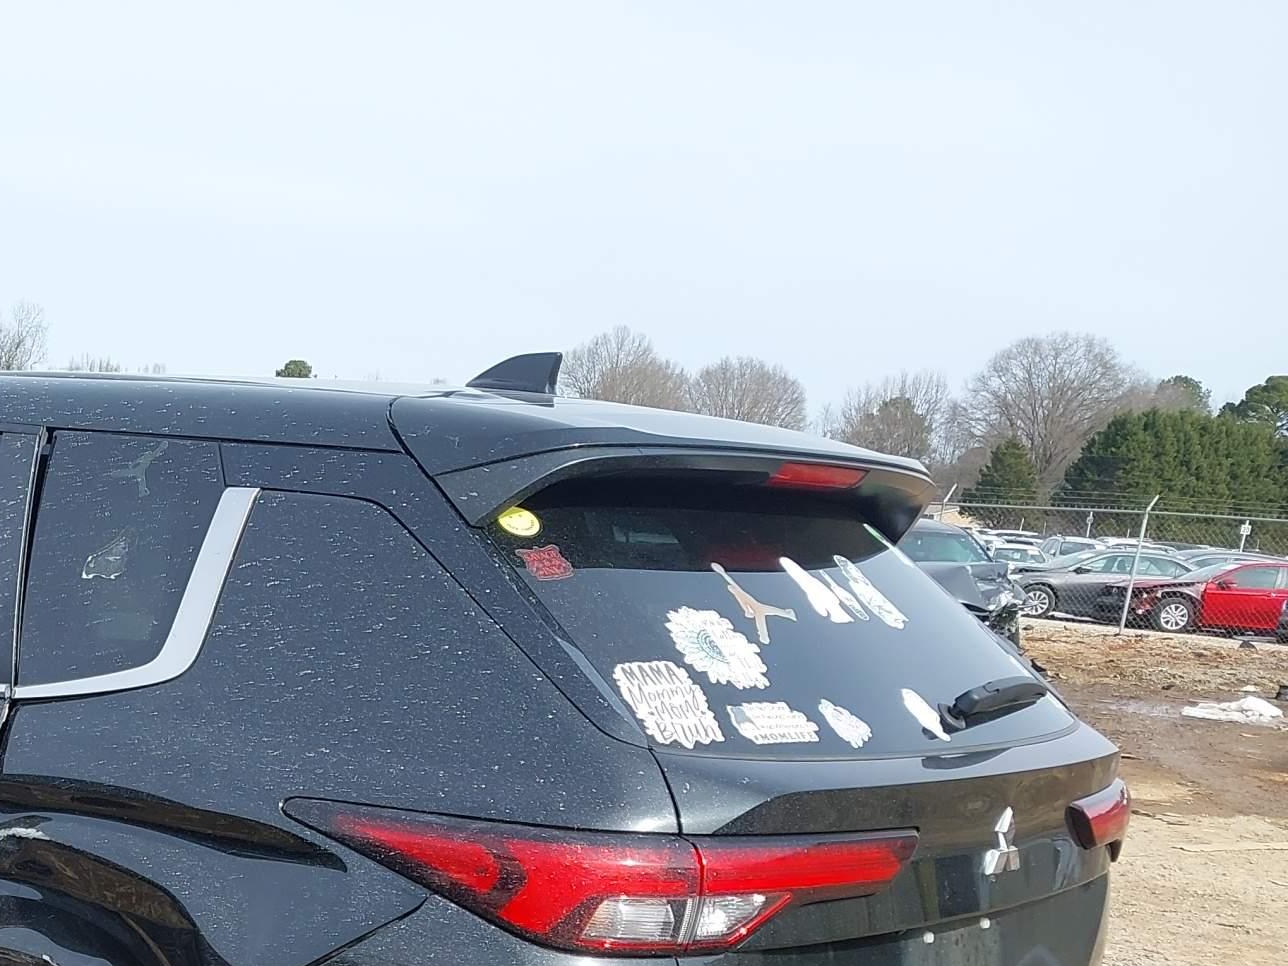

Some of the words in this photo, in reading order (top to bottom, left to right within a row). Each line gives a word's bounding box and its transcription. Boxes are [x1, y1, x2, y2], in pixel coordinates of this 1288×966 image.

[620, 663, 684, 686] MAMA
[626, 683, 700, 711] Mommy
[654, 718, 719, 744] Bruh
[754, 730, 815, 741] #MOMLIFE
